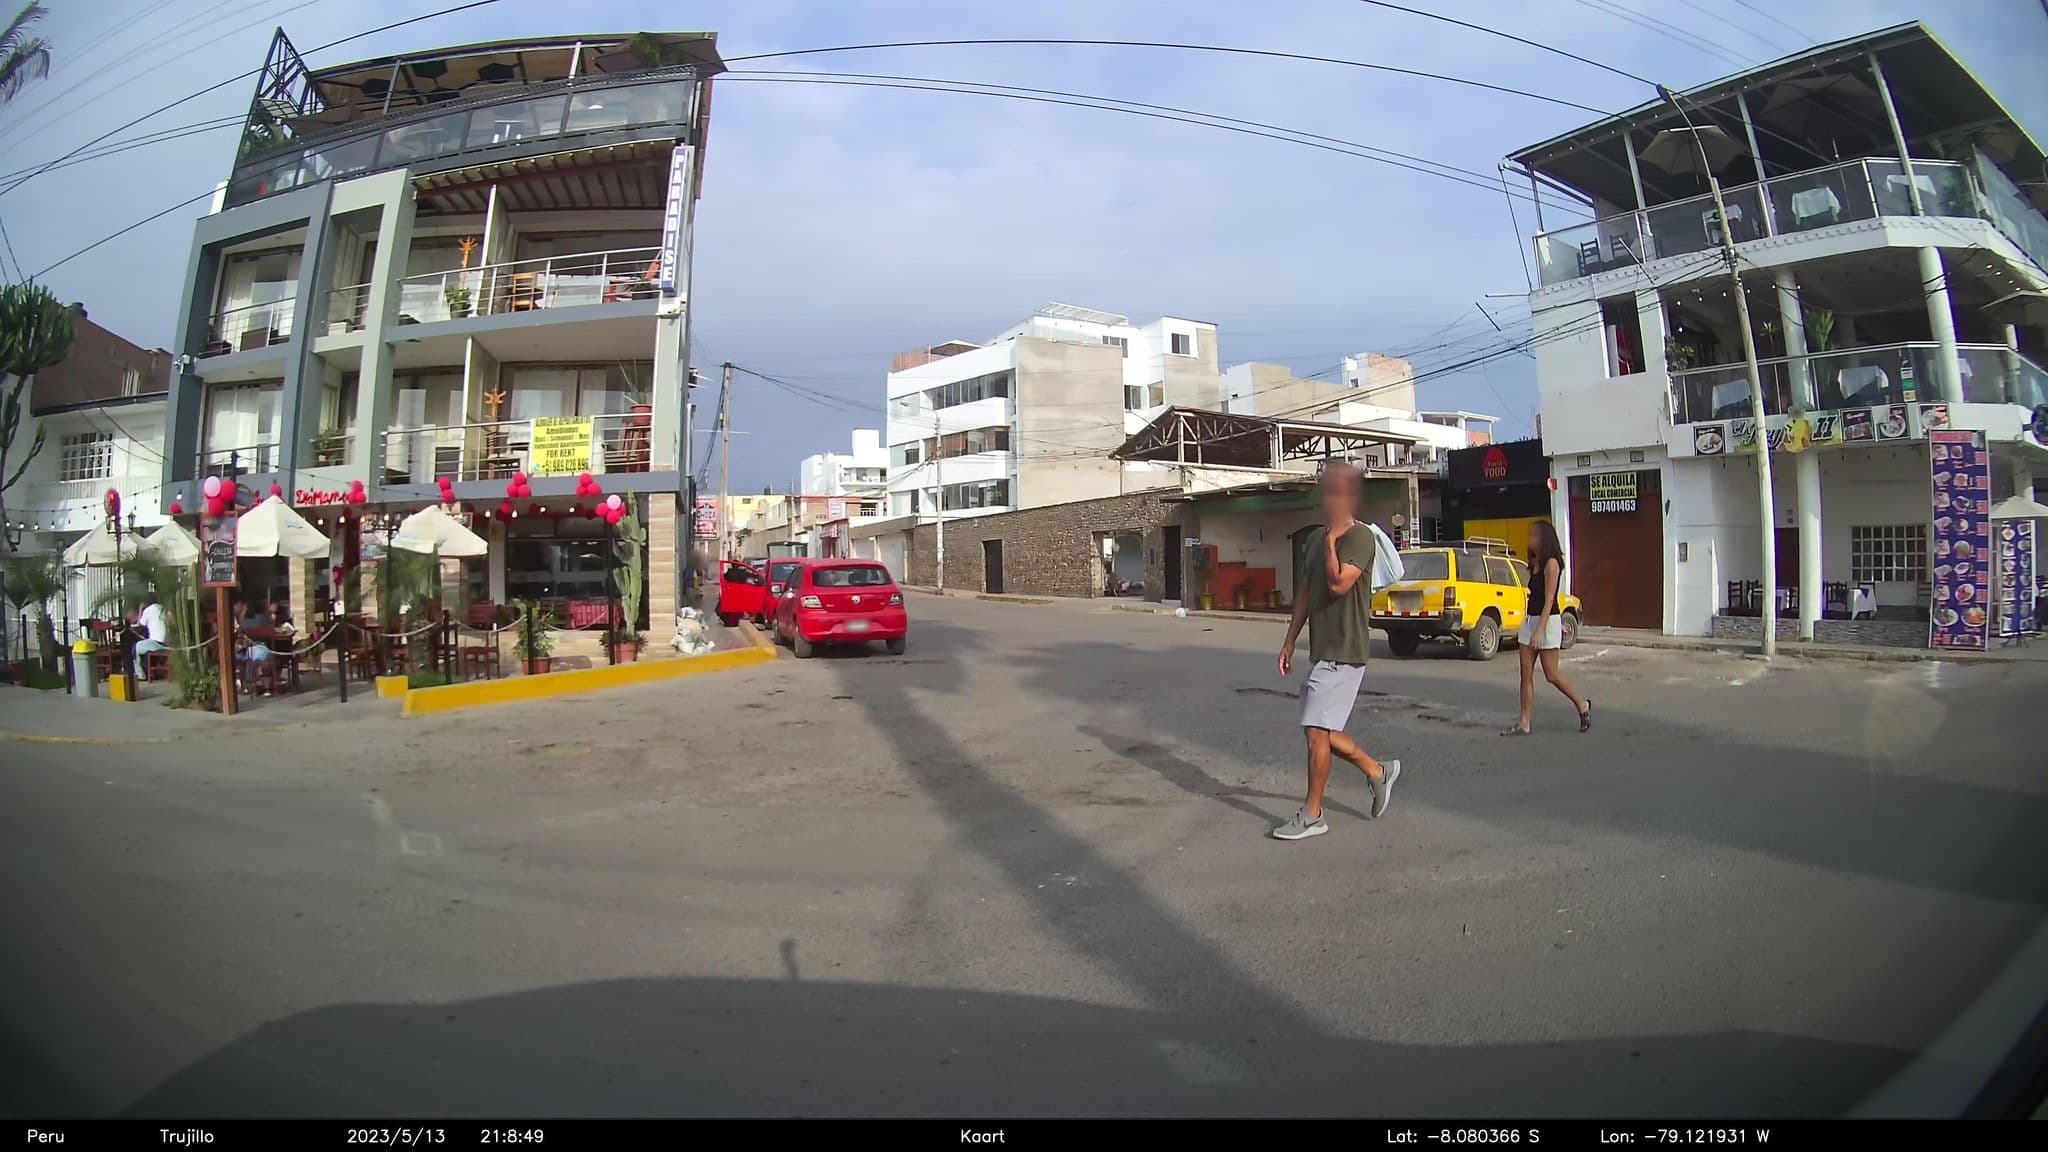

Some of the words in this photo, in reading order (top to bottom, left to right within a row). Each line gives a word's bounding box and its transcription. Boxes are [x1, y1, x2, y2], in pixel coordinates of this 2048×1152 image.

[662, 153, 685, 282] PARADISE
[546, 450, 558, 458] FOR
[560, 448, 576, 457] RENT
[1591, 475, 1601, 488] SE
[1602, 473, 1636, 488] ALQUILA
[1591, 489, 1606, 499] LOCAL
[1606, 487, 1636, 498] COMERCIAL
[1591, 499, 1636, 513] 987401463
